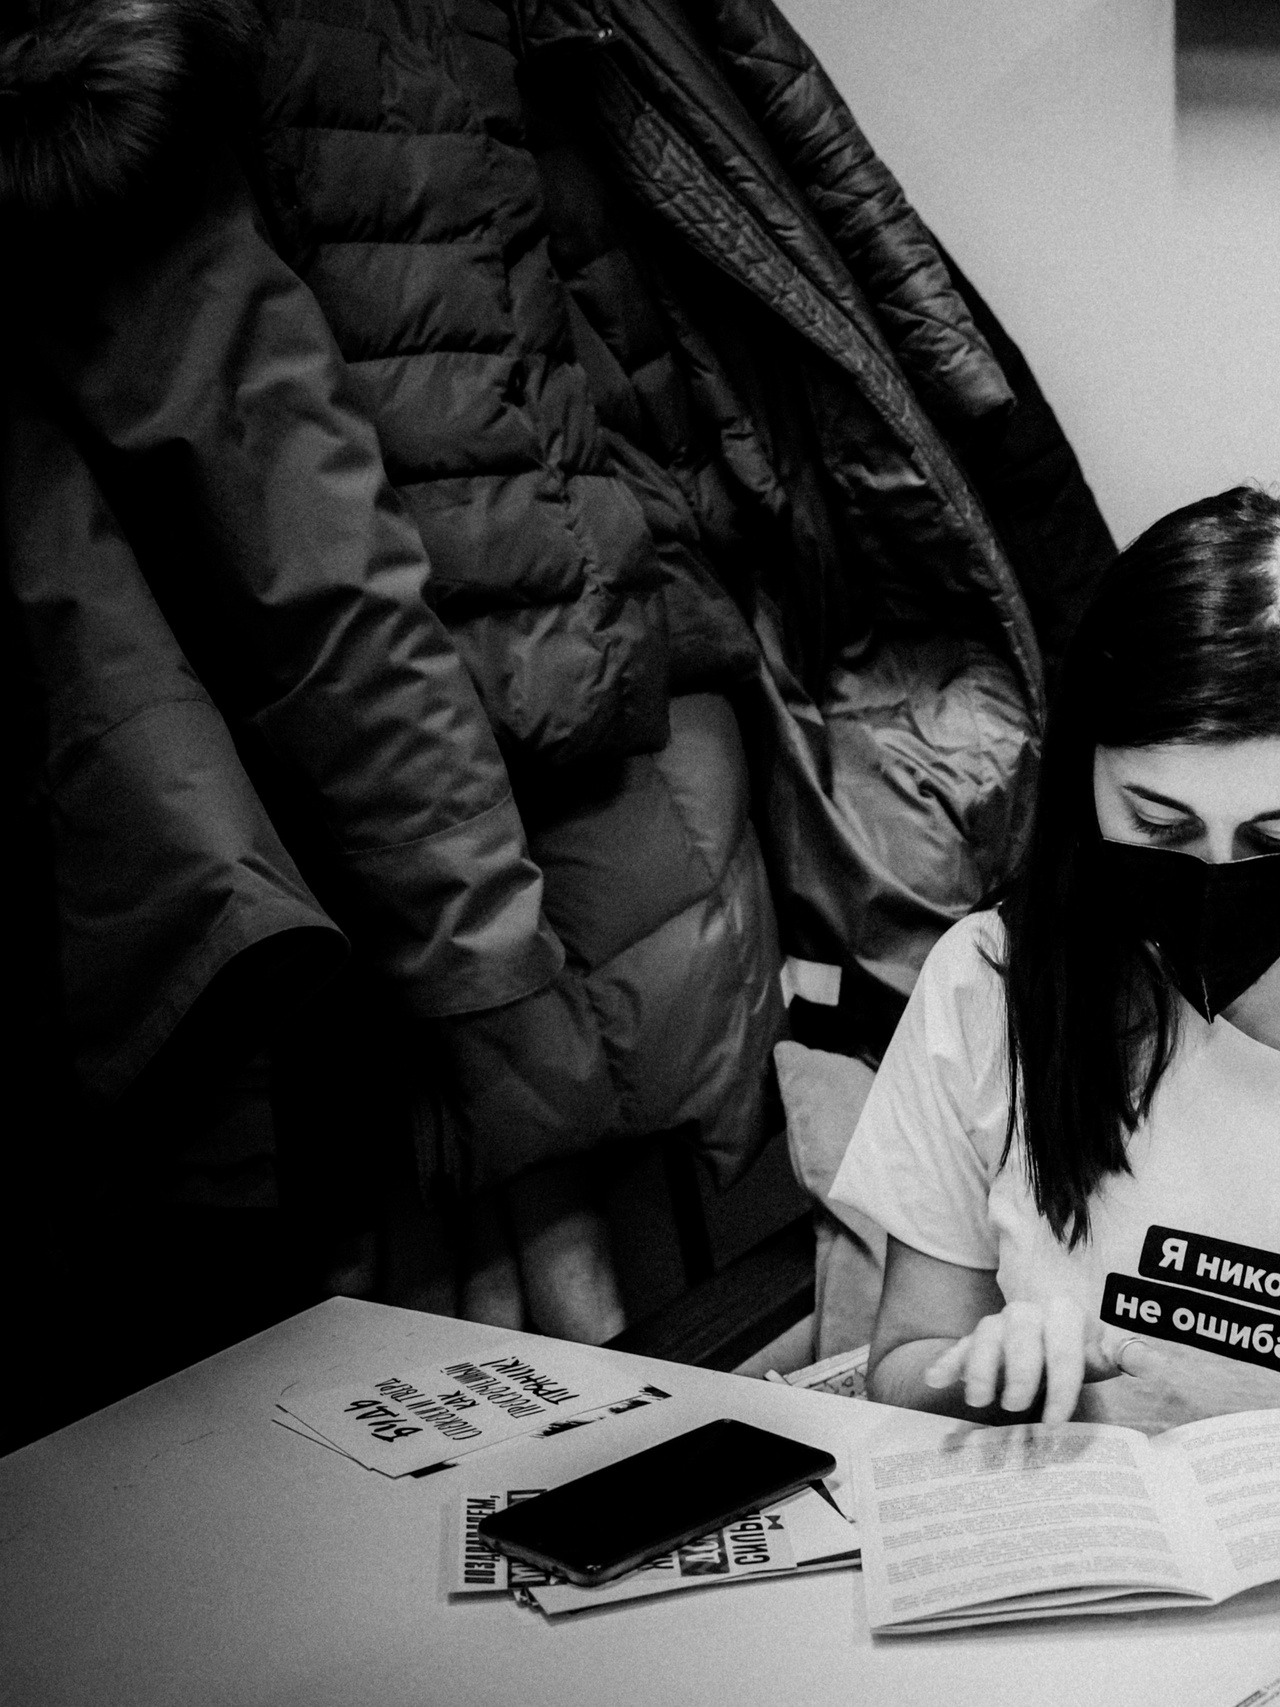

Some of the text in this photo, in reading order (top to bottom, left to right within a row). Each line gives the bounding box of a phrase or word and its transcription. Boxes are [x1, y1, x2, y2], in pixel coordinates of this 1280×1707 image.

[1158, 1237, 1189, 1272] Я
[1115, 1292, 1162, 1324] не
[439, 1361, 547, 1419] ПРОСРОЧЕННЫЙ
[479, 1355, 581, 1406] ПРЯНИК!
[436, 1389, 481, 1411] КАК
[343, 1400, 424, 1443] БУДЬ
[413, 1405, 483, 1441] СПОКОЕН
